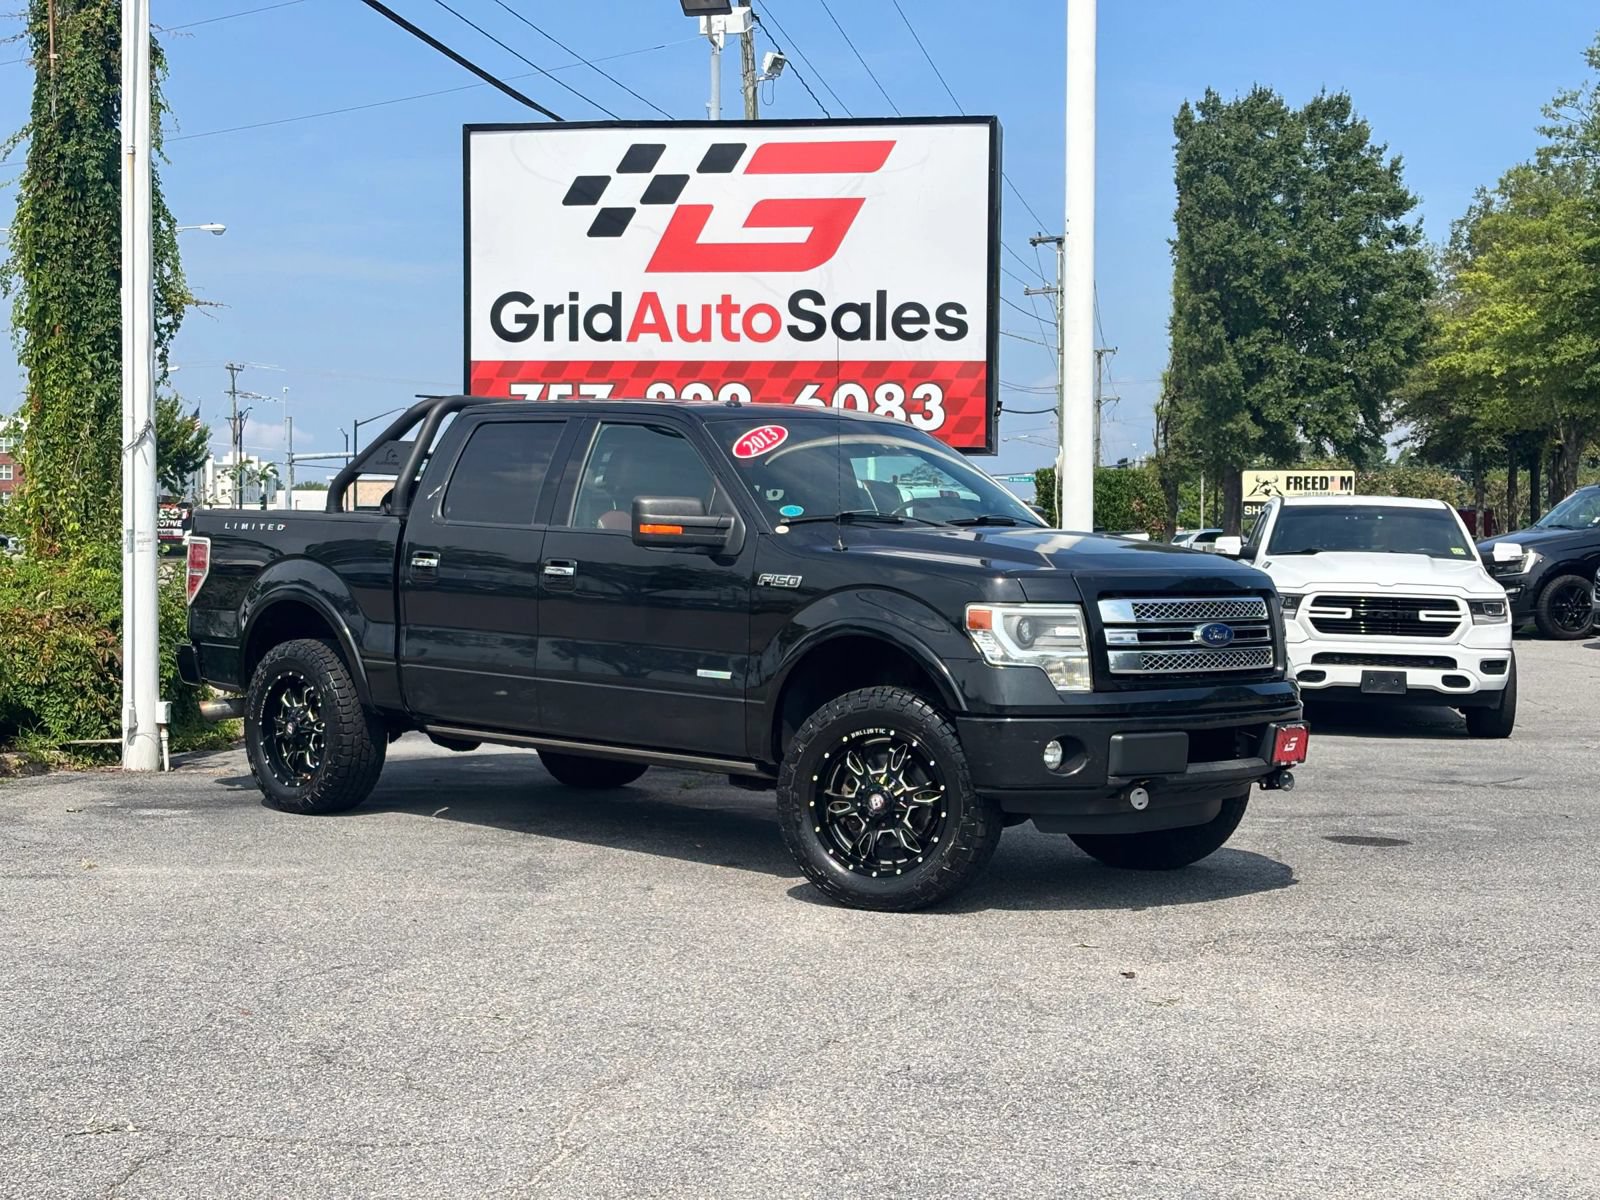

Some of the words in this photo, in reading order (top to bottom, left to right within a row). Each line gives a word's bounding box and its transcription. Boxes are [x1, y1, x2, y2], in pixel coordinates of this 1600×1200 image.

[743, 428, 779, 455] 2013
[224, 522, 286, 531] LIMITED
[1208, 626, 1229, 640] Ford
